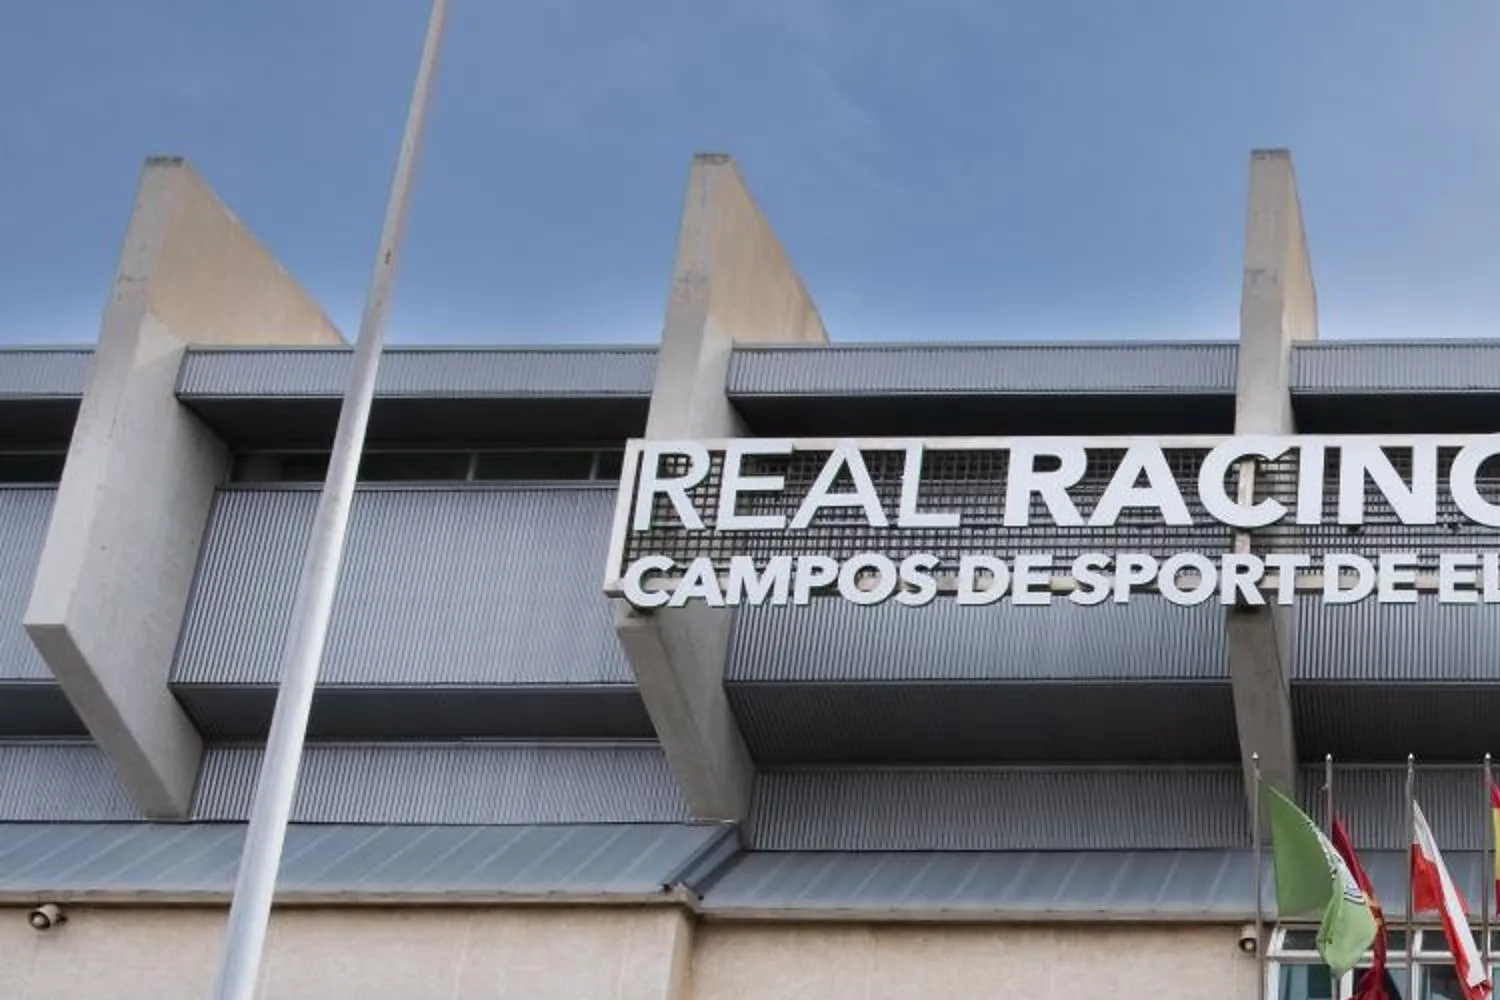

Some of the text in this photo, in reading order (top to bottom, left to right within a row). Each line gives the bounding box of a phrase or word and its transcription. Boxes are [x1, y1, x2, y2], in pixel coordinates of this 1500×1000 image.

[633, 438, 960, 531] REAL
[622, 553, 939, 608] CAMPOS
[957, 553, 1054, 606] DE
[1070, 551, 1312, 607] SPORT
[1322, 552, 1420, 605] DE
